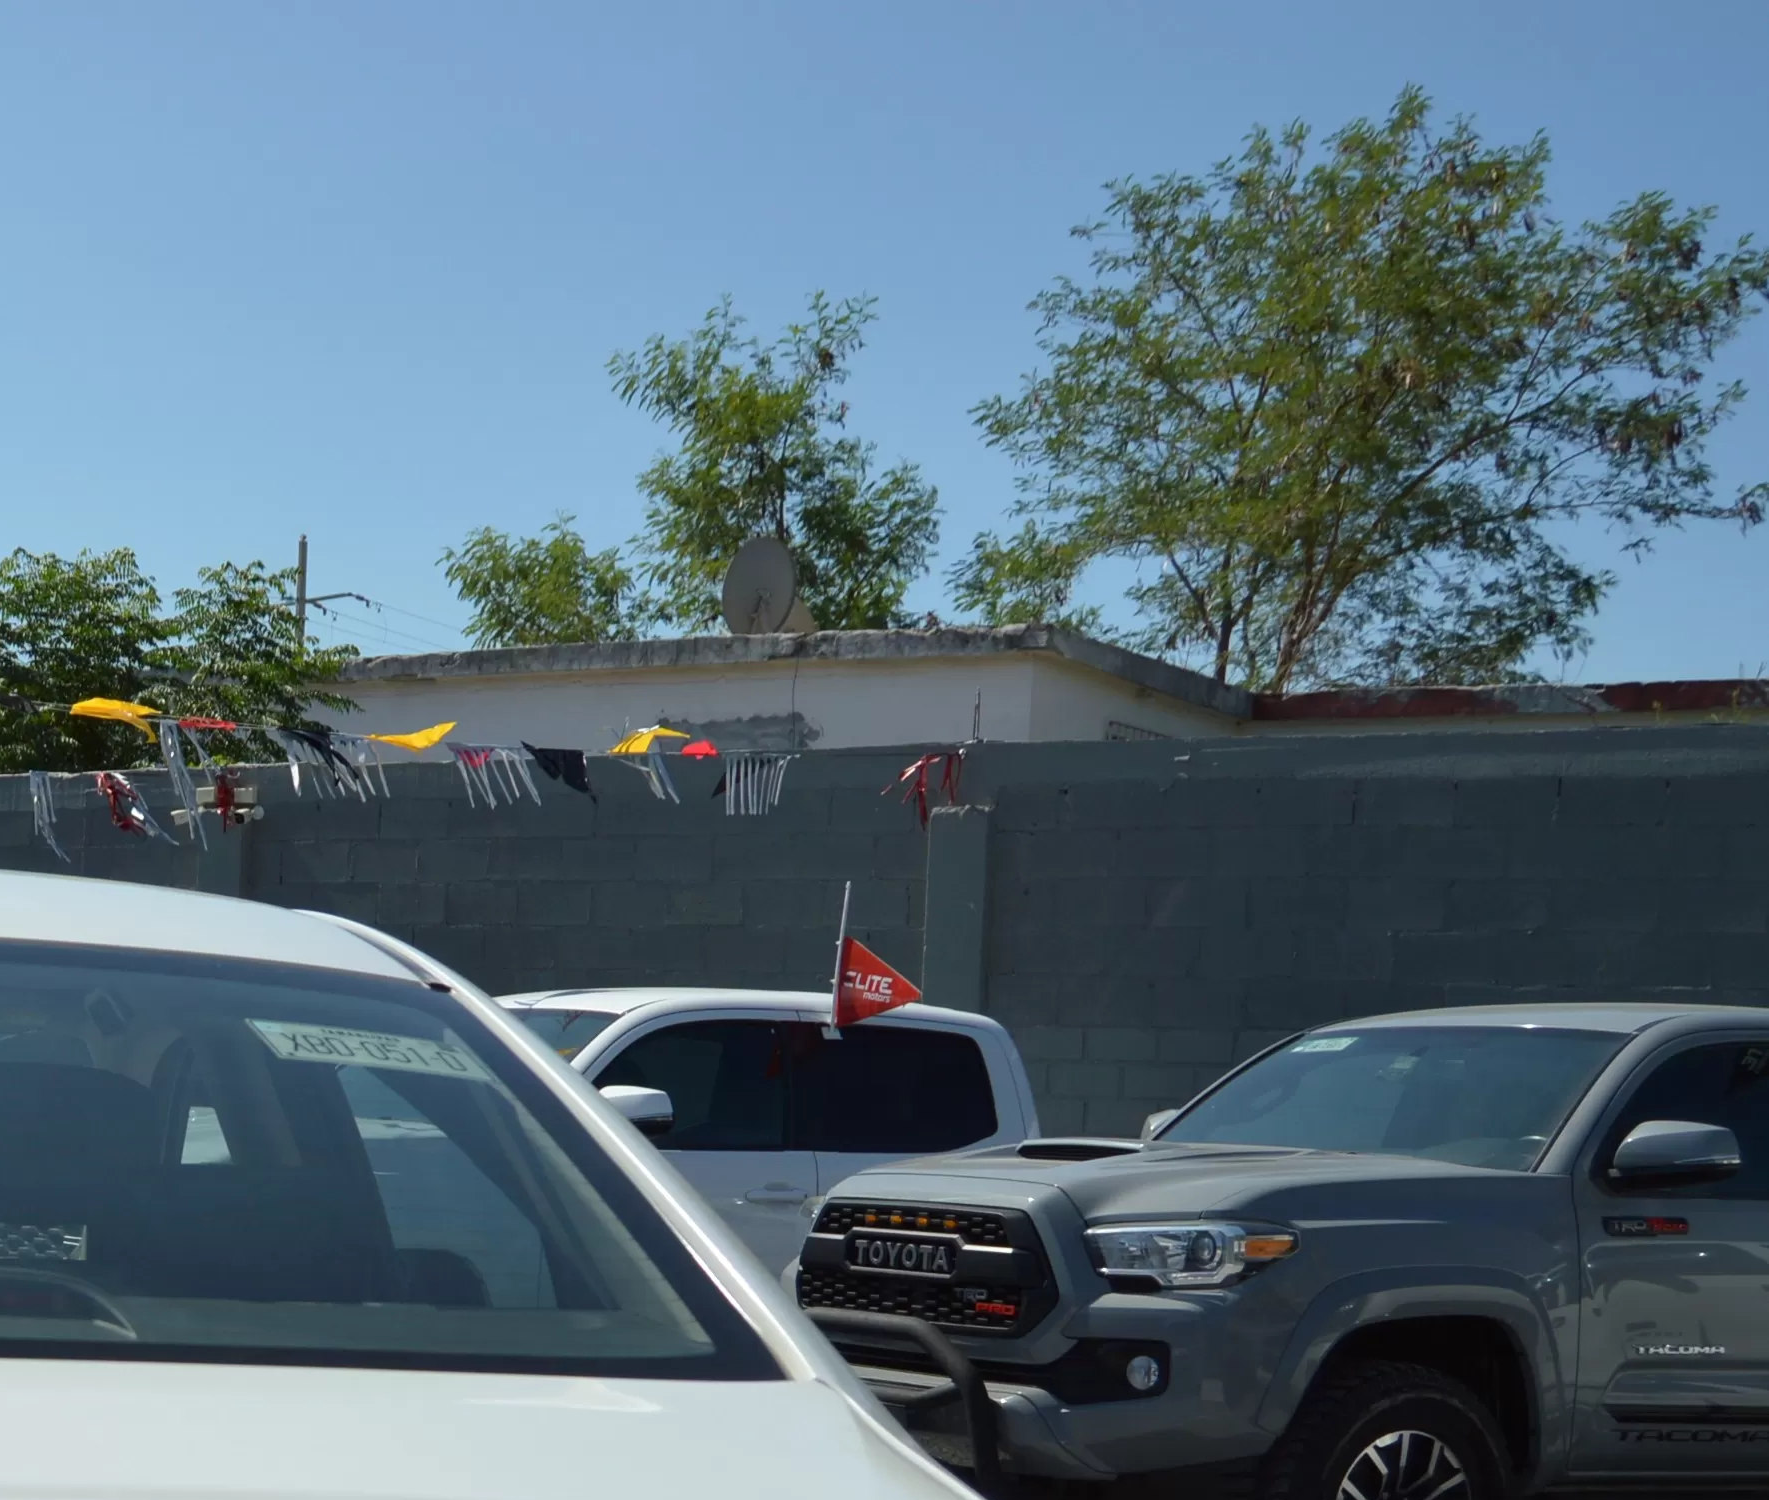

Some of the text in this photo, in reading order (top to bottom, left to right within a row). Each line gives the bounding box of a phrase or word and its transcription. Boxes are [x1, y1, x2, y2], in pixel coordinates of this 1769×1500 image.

[843, 970, 893, 995] ELITE
[862, 991, 891, 1003] motors
[855, 1239, 949, 1271] TOYOTA
[975, 1301, 1015, 1316] PRO
[1632, 1344, 1726, 1355] TACOMA
